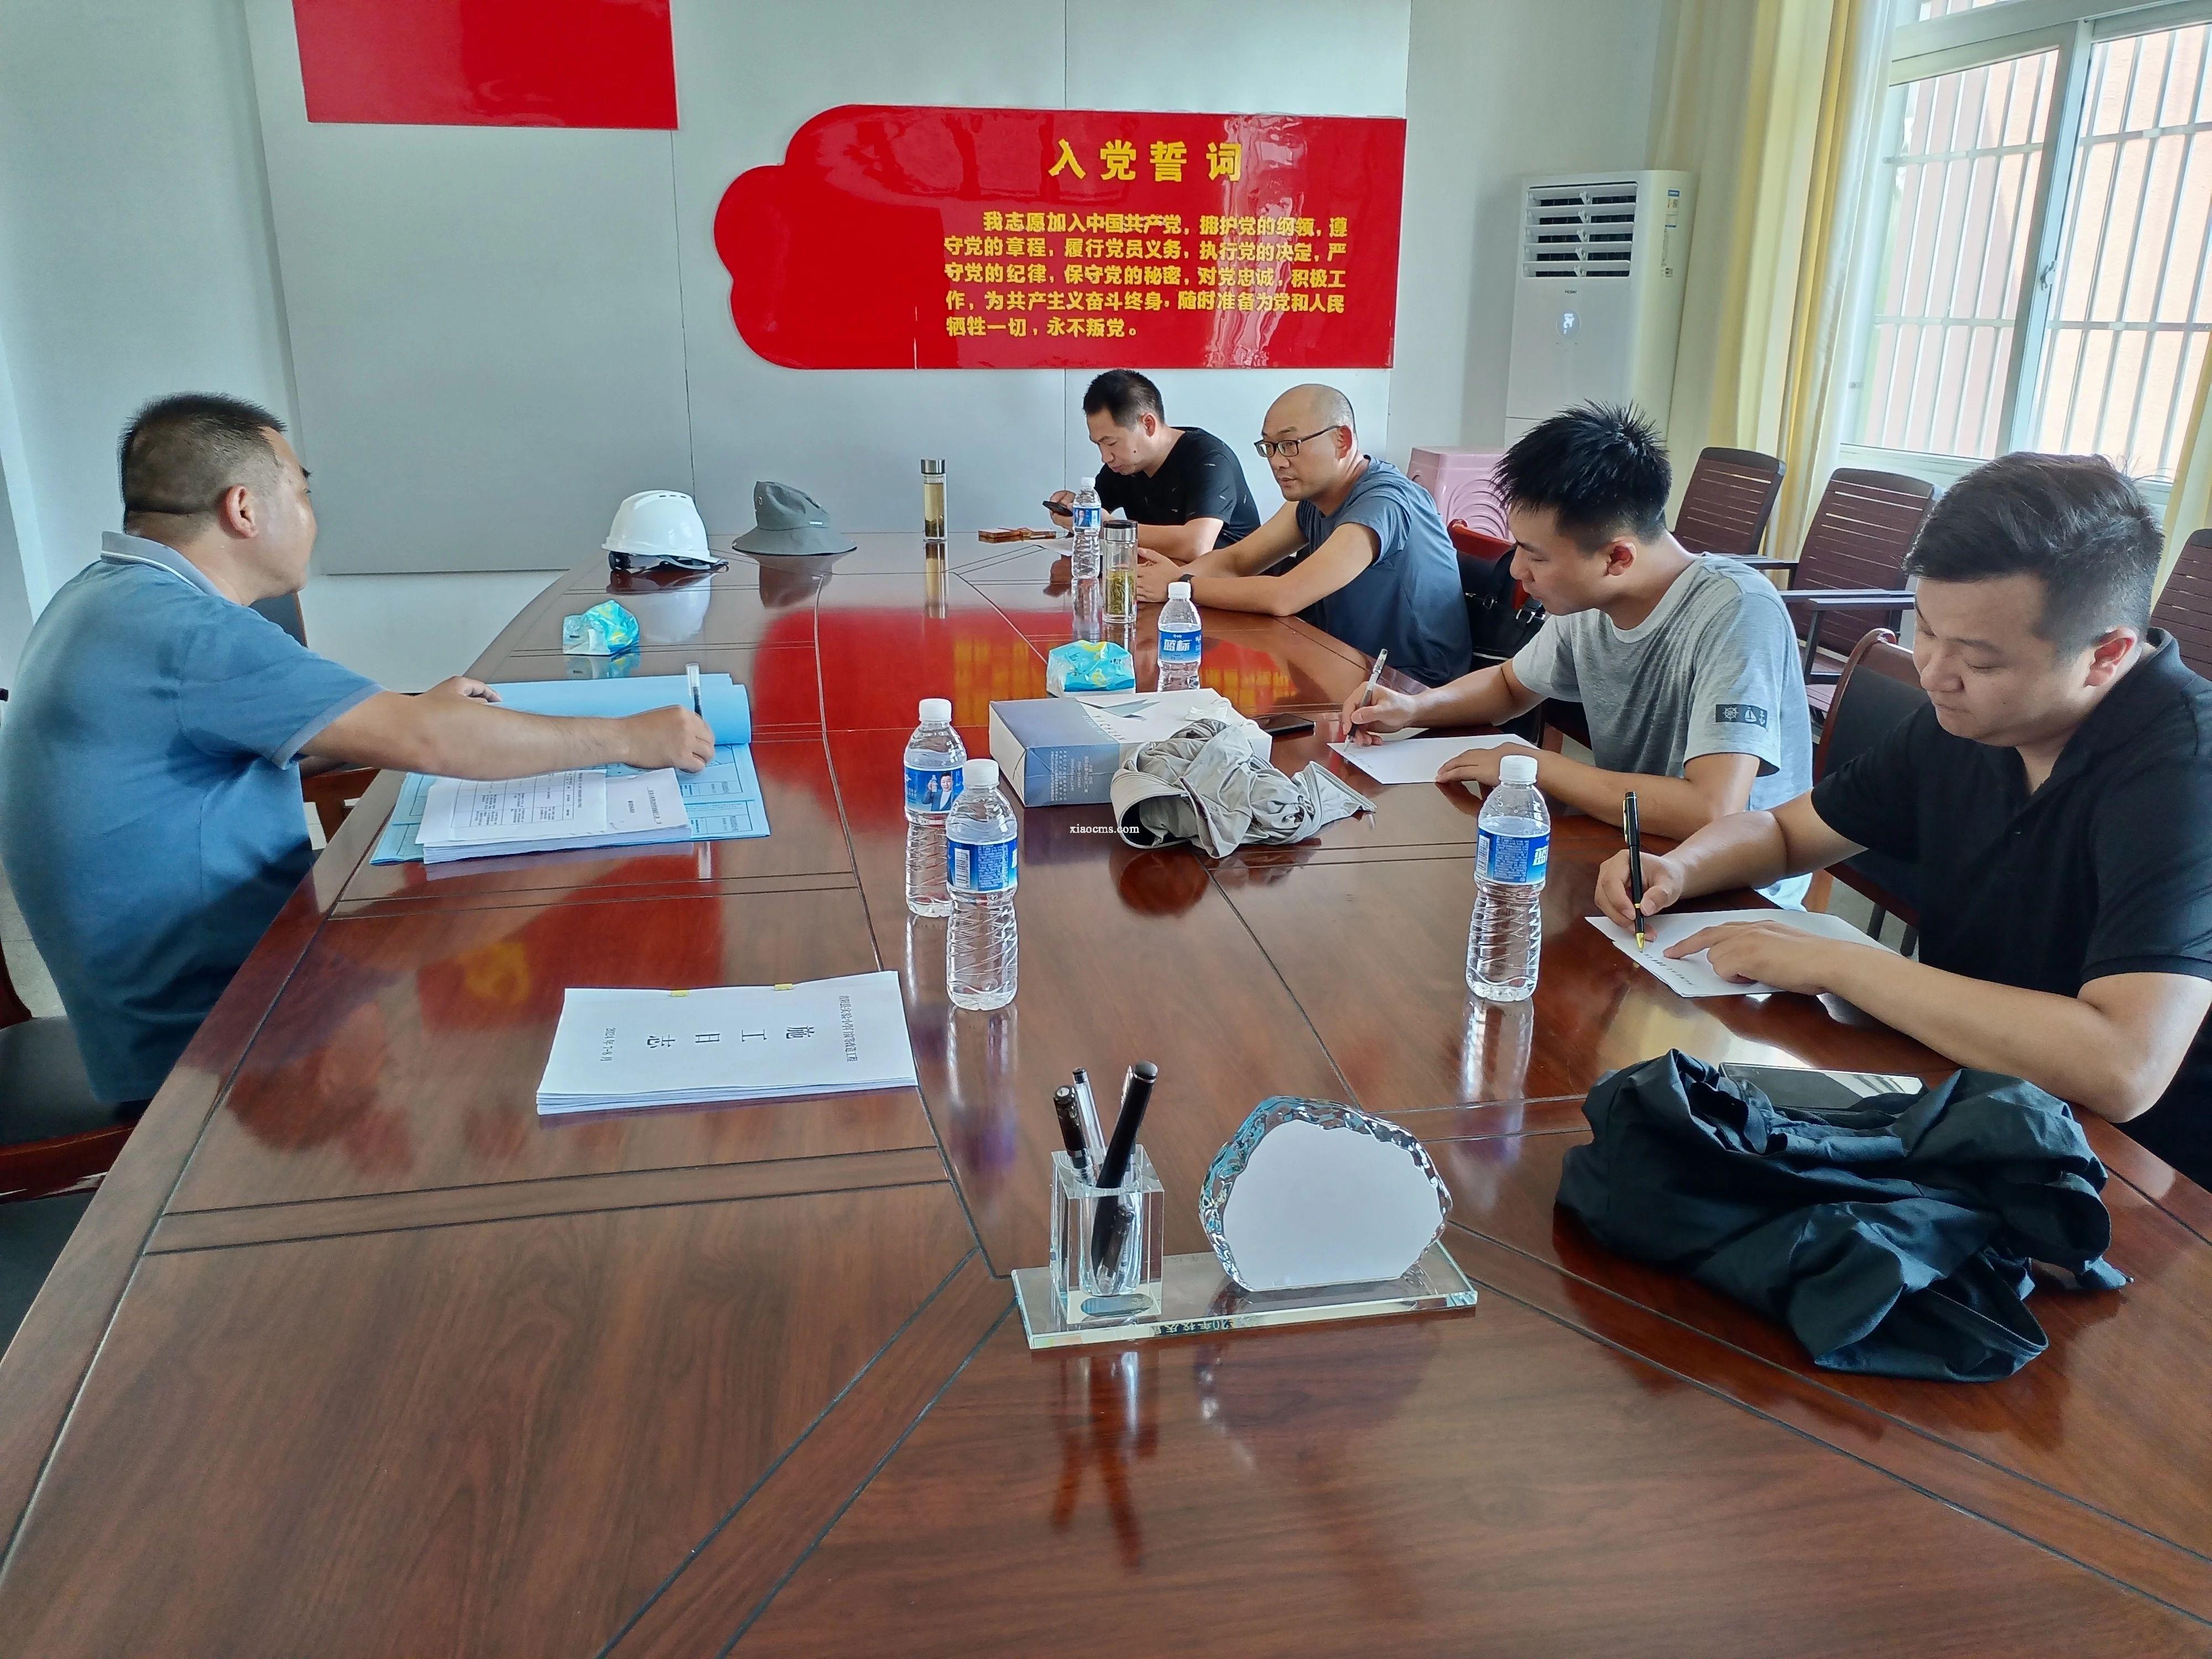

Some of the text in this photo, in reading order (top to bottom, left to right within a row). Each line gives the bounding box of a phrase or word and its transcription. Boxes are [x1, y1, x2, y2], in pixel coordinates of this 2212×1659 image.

[1048, 139, 1243, 181] 入党誓词
[946, 316, 1138, 337] 牺牲一切，永不叛党。
[646, 1025, 815, 1049] 施工日志
